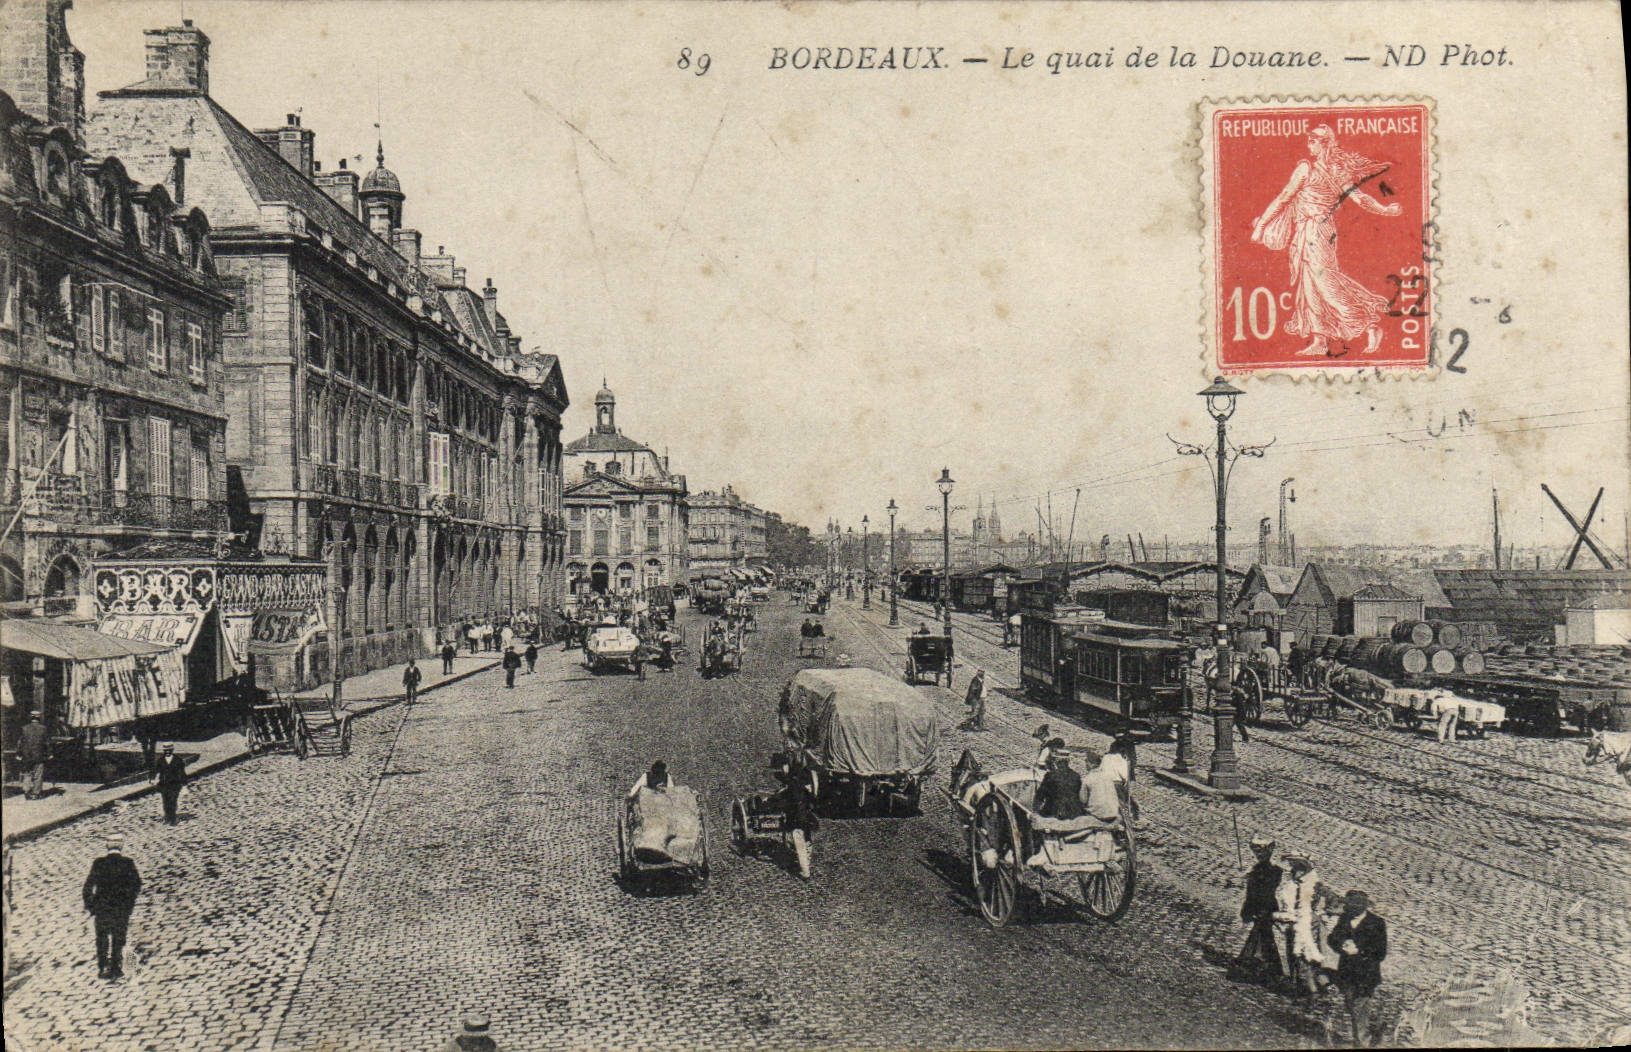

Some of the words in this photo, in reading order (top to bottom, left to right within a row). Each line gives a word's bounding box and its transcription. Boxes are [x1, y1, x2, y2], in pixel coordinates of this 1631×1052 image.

[1222, 118, 1310, 138] REPUBLIQUE
[1337, 116, 1419, 137] FRANÇAISE
[1401, 264, 1420, 350] POSTES
[120, 574, 192, 601] BAR
[222, 573, 260, 599] GRAND
[263, 573, 284, 598] BAR
[112, 619, 181, 641] BAR
